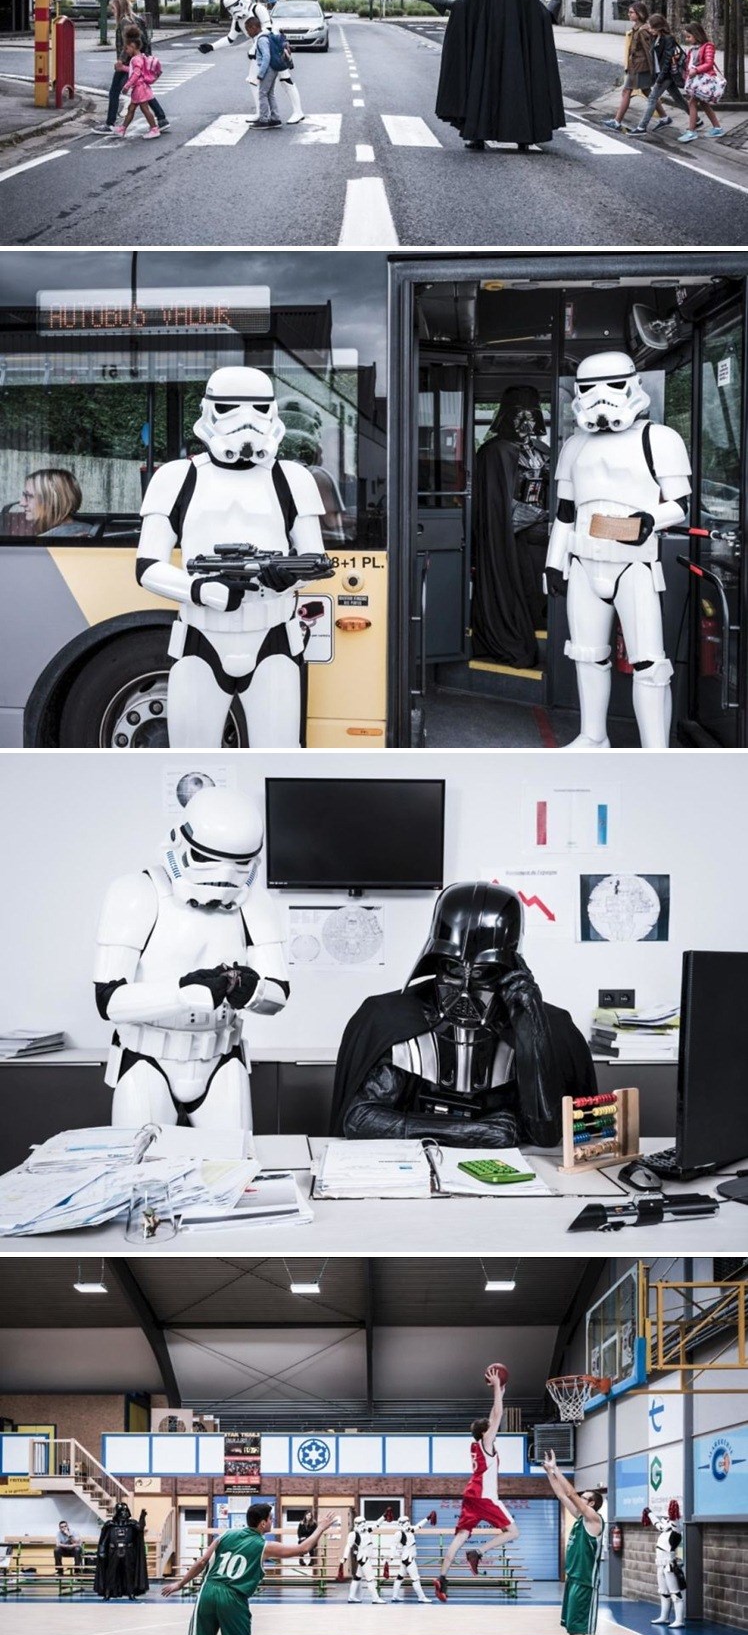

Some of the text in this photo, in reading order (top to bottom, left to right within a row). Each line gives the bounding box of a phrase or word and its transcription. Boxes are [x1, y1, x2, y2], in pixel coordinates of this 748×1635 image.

[50, 302, 146, 329] AUTOBUS
[362, 557, 385, 569] PL.
[217, 1551, 248, 1580] 10
